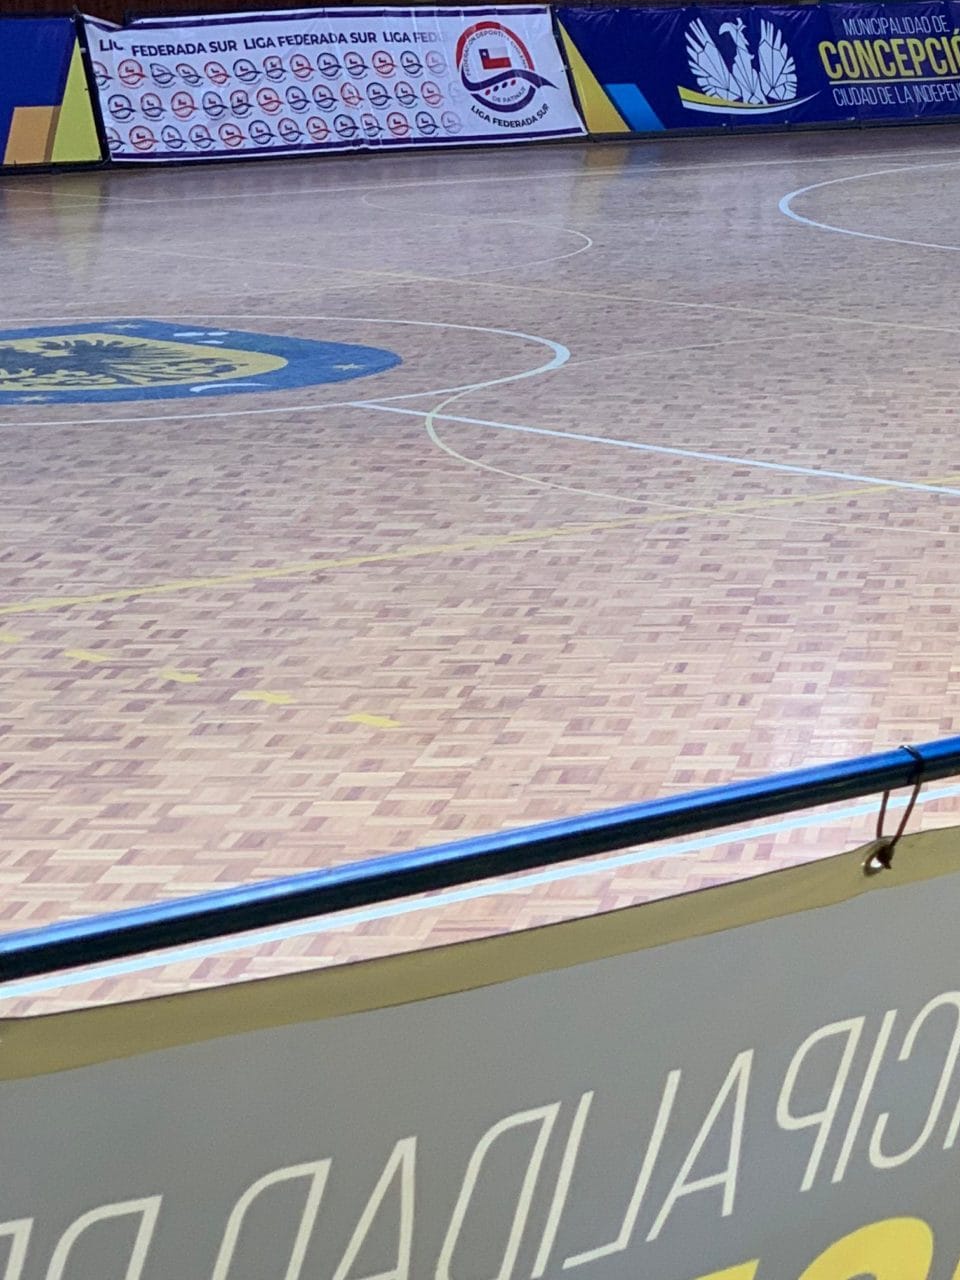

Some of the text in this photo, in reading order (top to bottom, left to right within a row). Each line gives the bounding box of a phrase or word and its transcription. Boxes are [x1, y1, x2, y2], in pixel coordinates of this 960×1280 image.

[842, 15, 950, 36] MUNICIPALIDAD DE
[131, 43, 206, 57] FEDERADA
[208, 40, 238, 53] SUR
[243, 36, 276, 51] LIGA
[277, 32, 348, 47] FEDERADA
[350, 32, 378, 44] SUR
[383, 31, 411, 44] LIGA
[832, 86, 878, 107] CIUDAD
[879, 85, 896, 105] DE
[895, 84, 914, 103] LA
[471, 103, 550, 128] LIGA FEDERADA SUR
